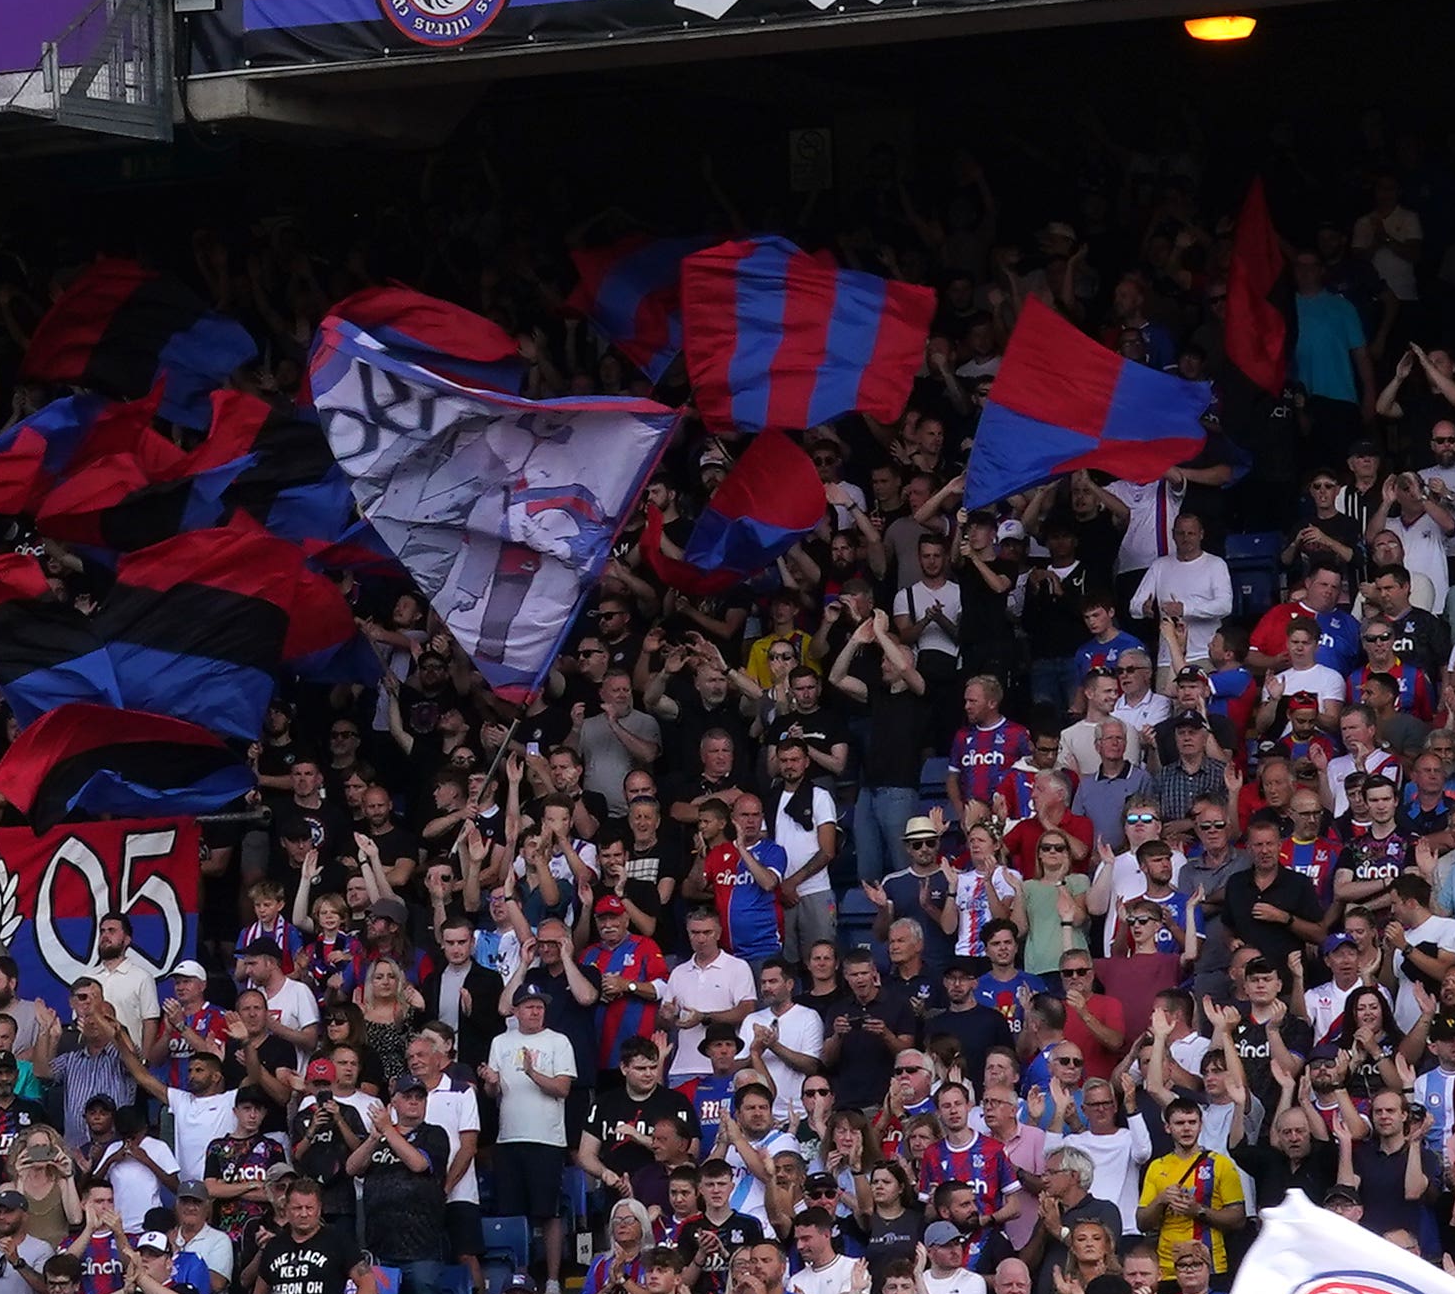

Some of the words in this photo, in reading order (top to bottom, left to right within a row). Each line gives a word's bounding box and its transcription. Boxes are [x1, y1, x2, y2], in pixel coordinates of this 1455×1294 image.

[962, 749, 1004, 767] cinch
[716, 870, 753, 885] cinch
[1356, 862, 1398, 879] cinch
[37, 829, 185, 985] 05
[223, 1163, 266, 1181] cinch
[82, 1258, 122, 1276] cinch
[270, 1253, 290, 1270] THE
[280, 1265, 309, 1278] KEYS
[306, 1281, 324, 1294] OH
